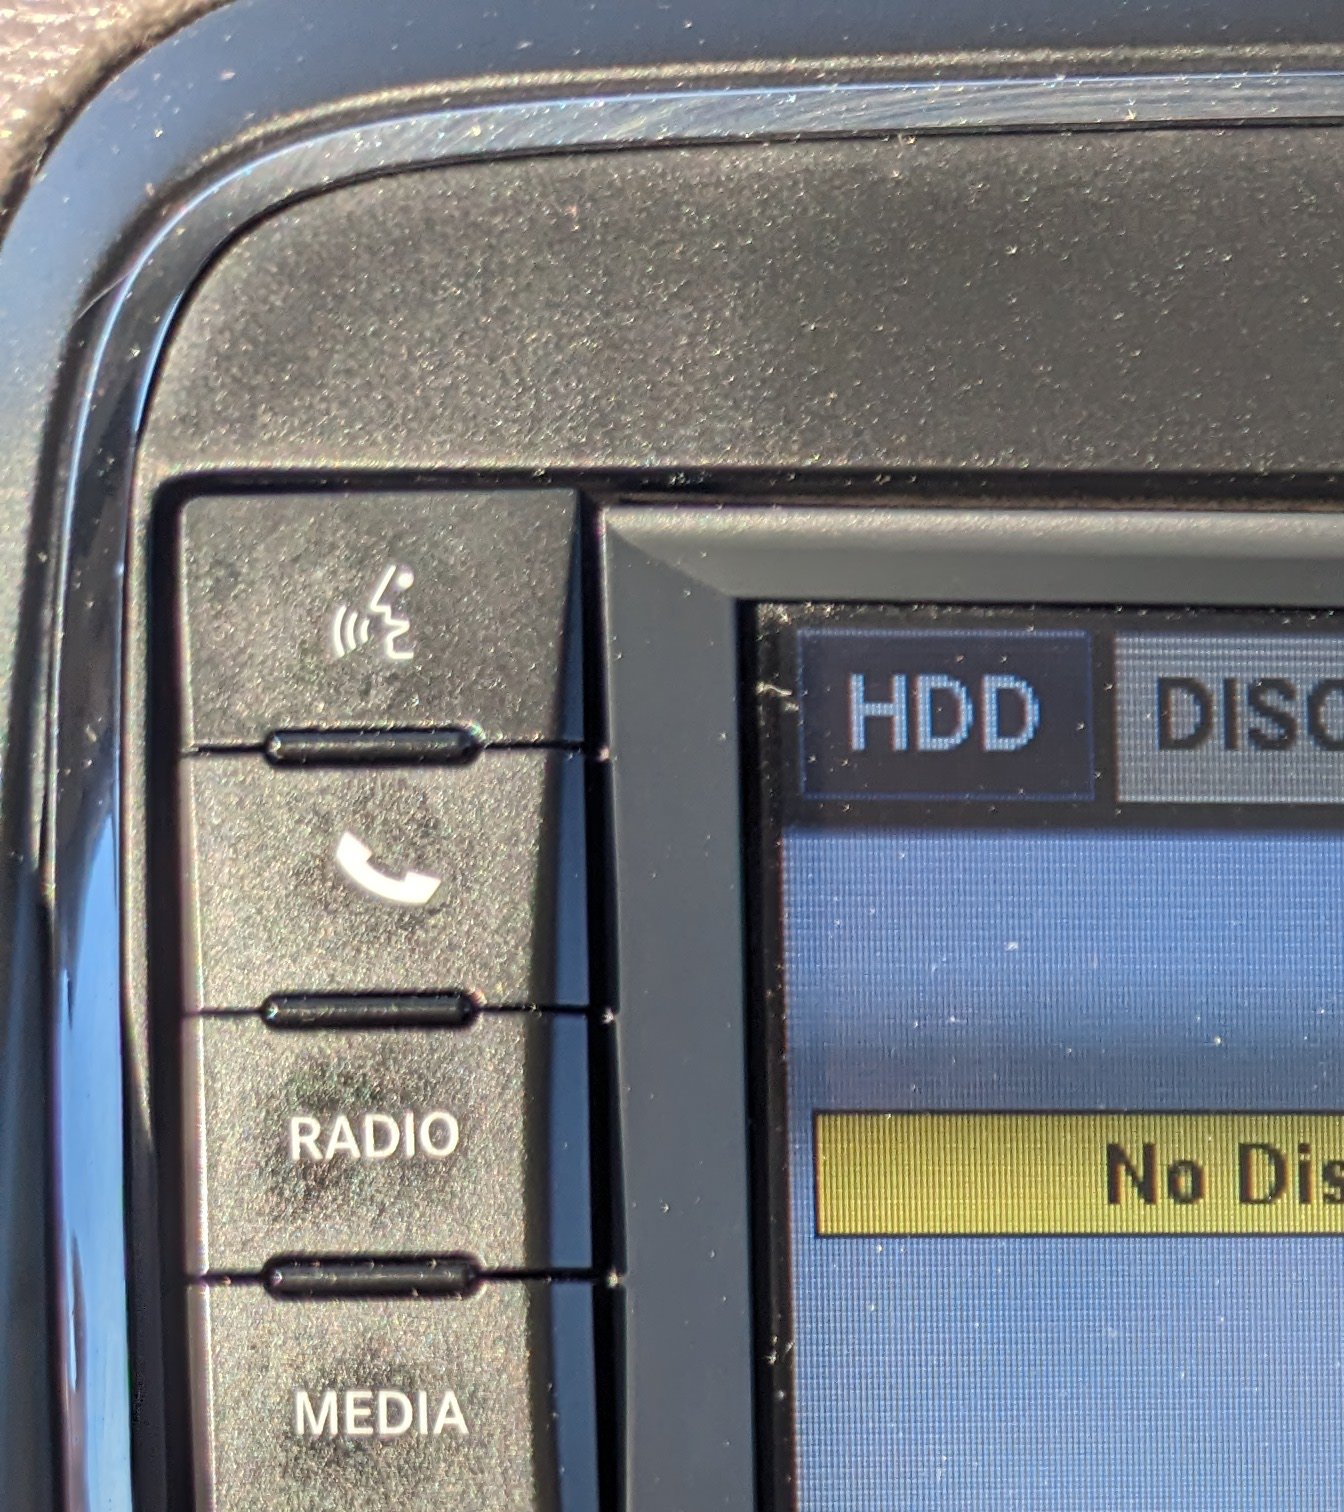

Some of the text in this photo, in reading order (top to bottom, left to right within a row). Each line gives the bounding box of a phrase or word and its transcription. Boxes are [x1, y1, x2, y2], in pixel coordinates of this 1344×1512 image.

[848, 673, 1041, 752] HDD
[288, 1111, 461, 1160] RADIO
[1106, 1142, 1205, 1205] No
[293, 1389, 469, 1435] MEDIA
